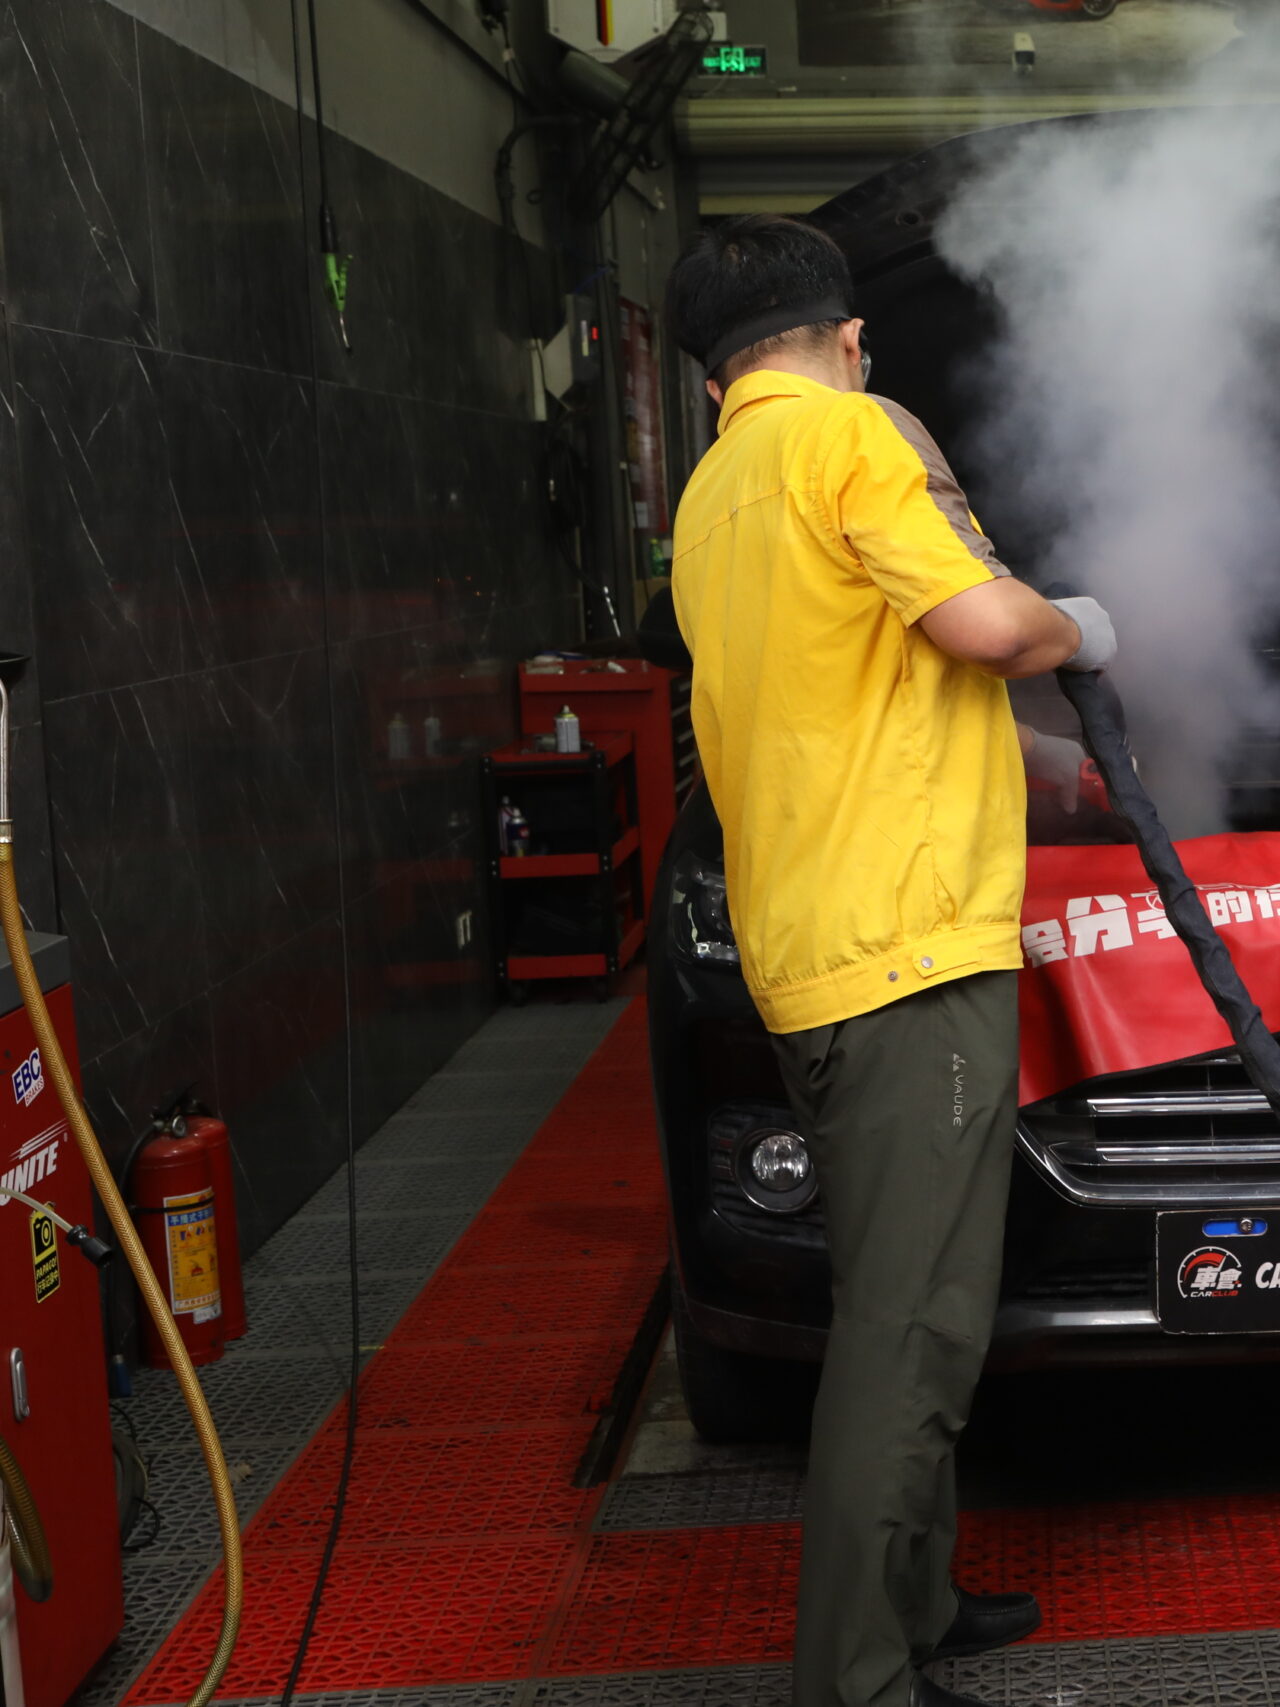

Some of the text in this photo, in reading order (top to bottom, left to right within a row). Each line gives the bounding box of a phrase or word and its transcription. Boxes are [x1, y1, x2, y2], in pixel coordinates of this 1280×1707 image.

[13, 1052, 41, 1102] EBC
[953, 1074, 965, 1127] VAUDE
[1190, 1290, 1238, 1298] CARCLUB
